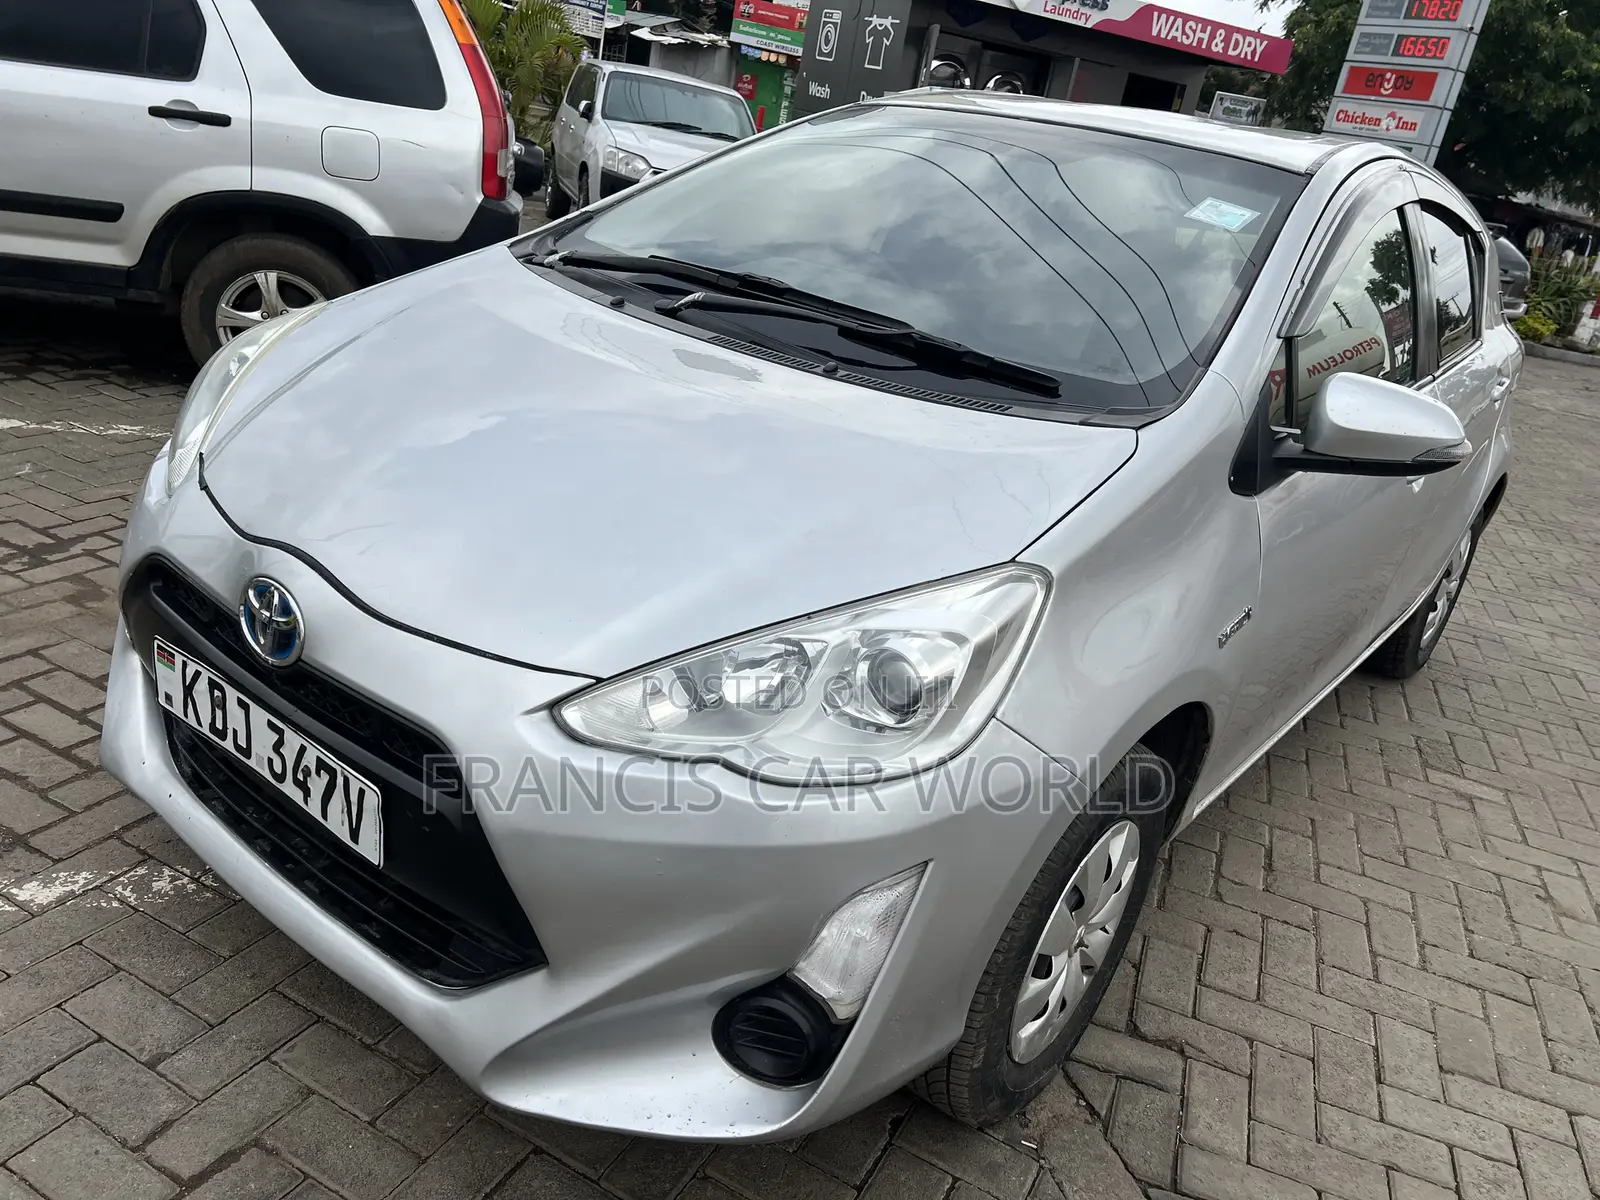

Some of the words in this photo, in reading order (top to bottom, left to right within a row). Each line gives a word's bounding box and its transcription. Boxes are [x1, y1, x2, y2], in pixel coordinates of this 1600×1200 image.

[1043, 0, 1092, 25] Laundry
[756, 40, 774, 48] COAST
[774, 44, 799, 54] WIRELESS
[1151, 11, 1211, 49] WASH
[1211, 29, 1225, 53] &
[1228, 32, 1268, 62] DRY
[1400, 36, 1450, 58] 16650
[808, 81, 831, 100] Wash
[1365, 72, 1415, 93] enjoy
[1335, 109, 1382, 127] Chicken
[1395, 116, 1418, 132] Inn
[182, 659, 252, 760] KDJ
[267, 718, 366, 846] 347V
